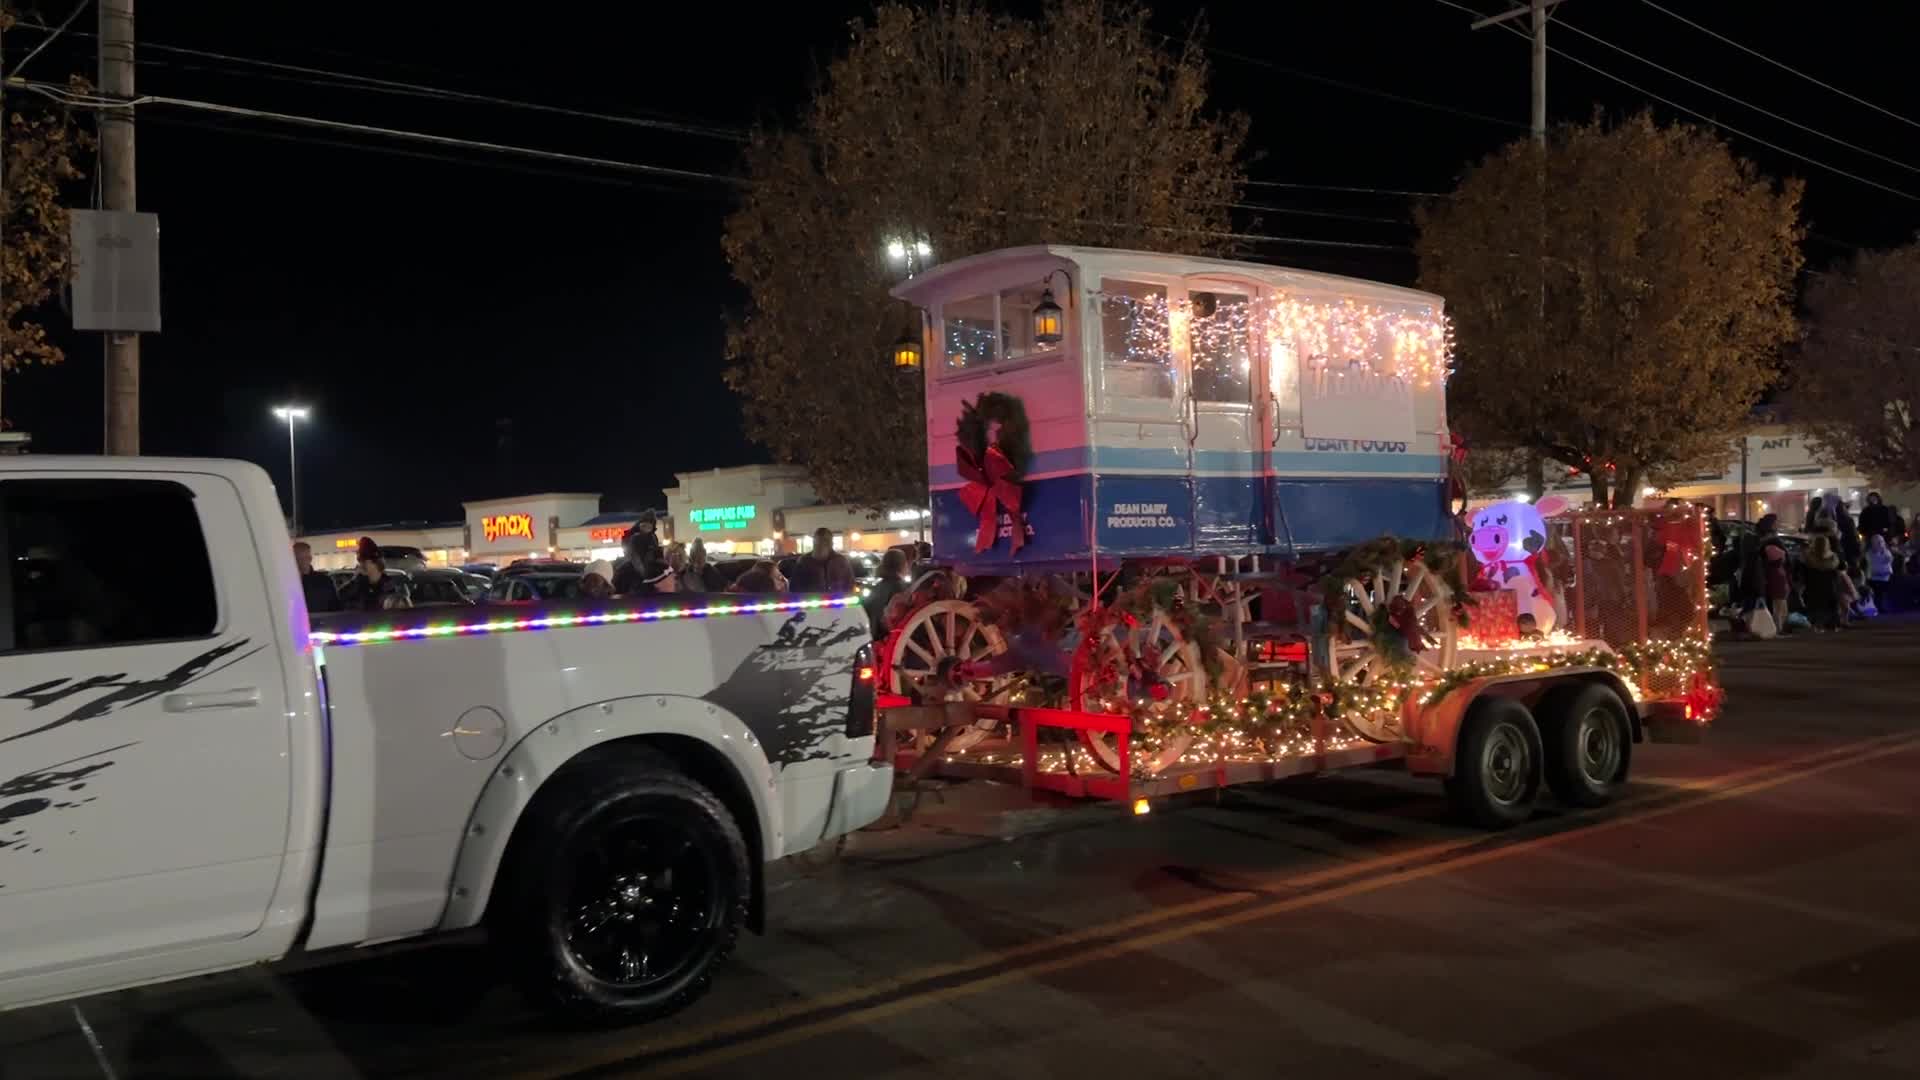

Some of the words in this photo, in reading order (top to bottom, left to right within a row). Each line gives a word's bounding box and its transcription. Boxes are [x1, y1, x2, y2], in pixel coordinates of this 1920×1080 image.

[1761, 438, 1792, 450] ANT
[1114, 503, 1140, 514] DEAN
[1141, 503, 1168, 514] DAIRY
[1107, 516, 1157, 529] PRODUCTS
[1158, 516, 1177, 528] CO.
